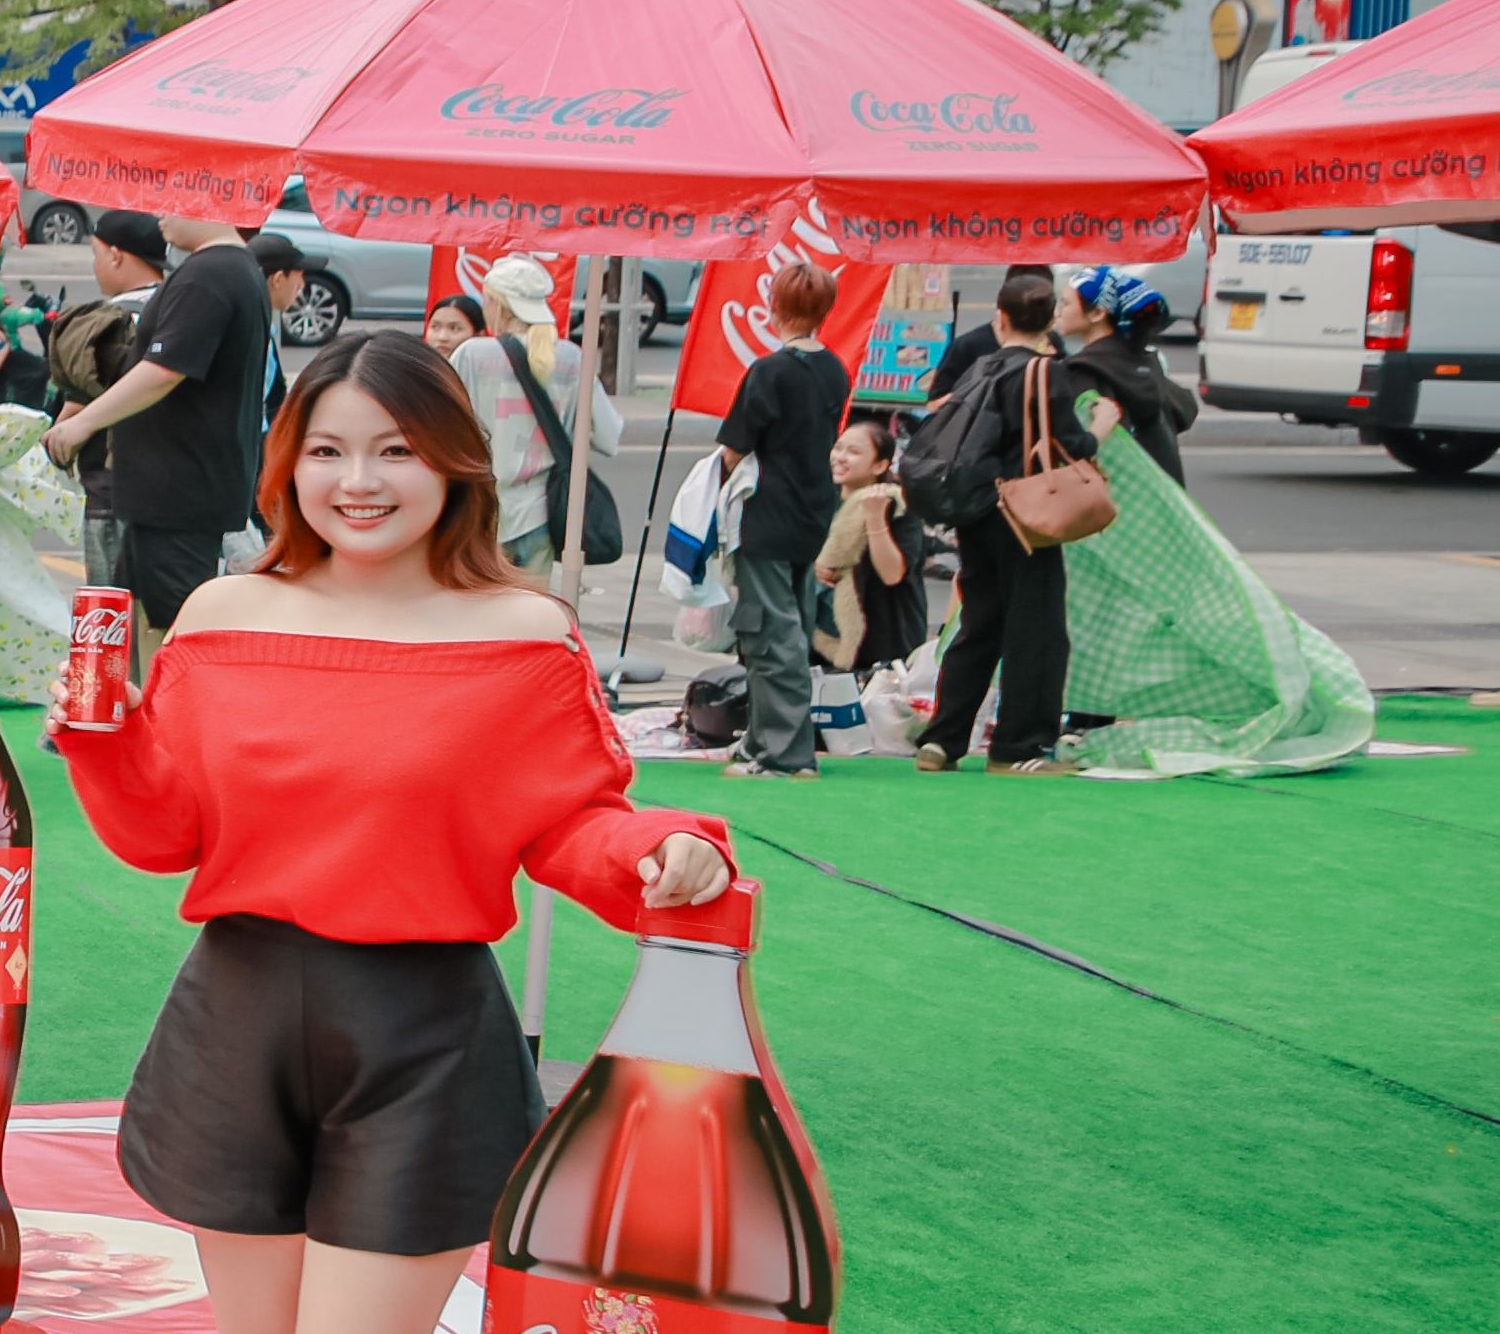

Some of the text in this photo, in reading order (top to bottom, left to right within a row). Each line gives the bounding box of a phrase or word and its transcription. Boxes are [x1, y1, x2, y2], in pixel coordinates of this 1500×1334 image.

[440, 83, 692, 130] Coca-Cola
[850, 89, 1037, 135] Coca-Cola
[466, 127, 636, 145] ZERO SUGAR
[908, 140, 962, 153] ZERO
[46, 153, 100, 181] Ngon
[107, 156, 166, 190] không
[1294, 156, 1382, 184] không
[1391, 149, 1486, 179] cưỡng
[334, 187, 432, 218] Ngon
[446, 190, 561, 229] không
[575, 200, 695, 239] cưỡng
[842, 215, 919, 244] Ngon
[930, 212, 1021, 243] không
[1032, 211, 1122, 243] cưỡng
